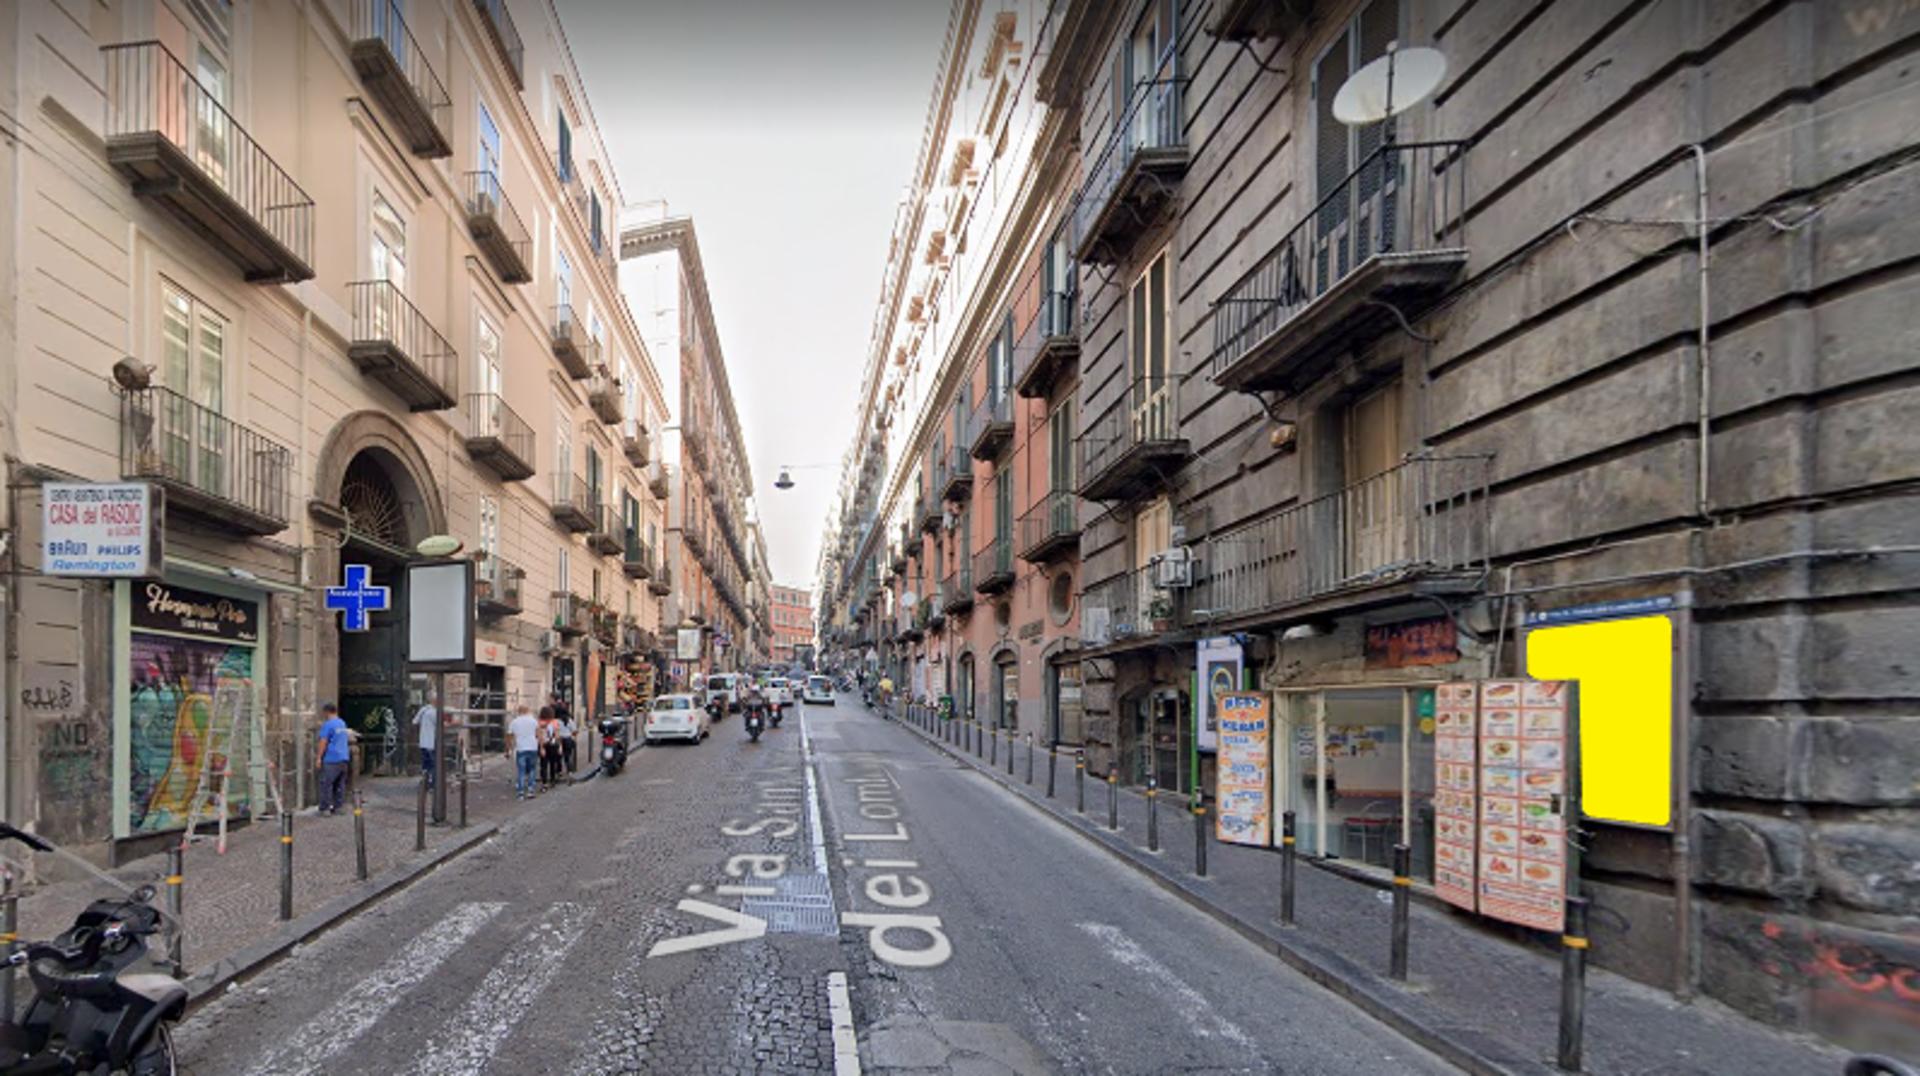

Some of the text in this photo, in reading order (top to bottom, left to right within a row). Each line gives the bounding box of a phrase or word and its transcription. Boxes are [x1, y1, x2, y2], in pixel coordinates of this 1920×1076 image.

[49, 503, 78, 525] CASA
[100, 503, 142, 524] RASOIO
[49, 540, 142, 556] BRAUN PHILIPS
[53, 560, 137, 572] Remington
